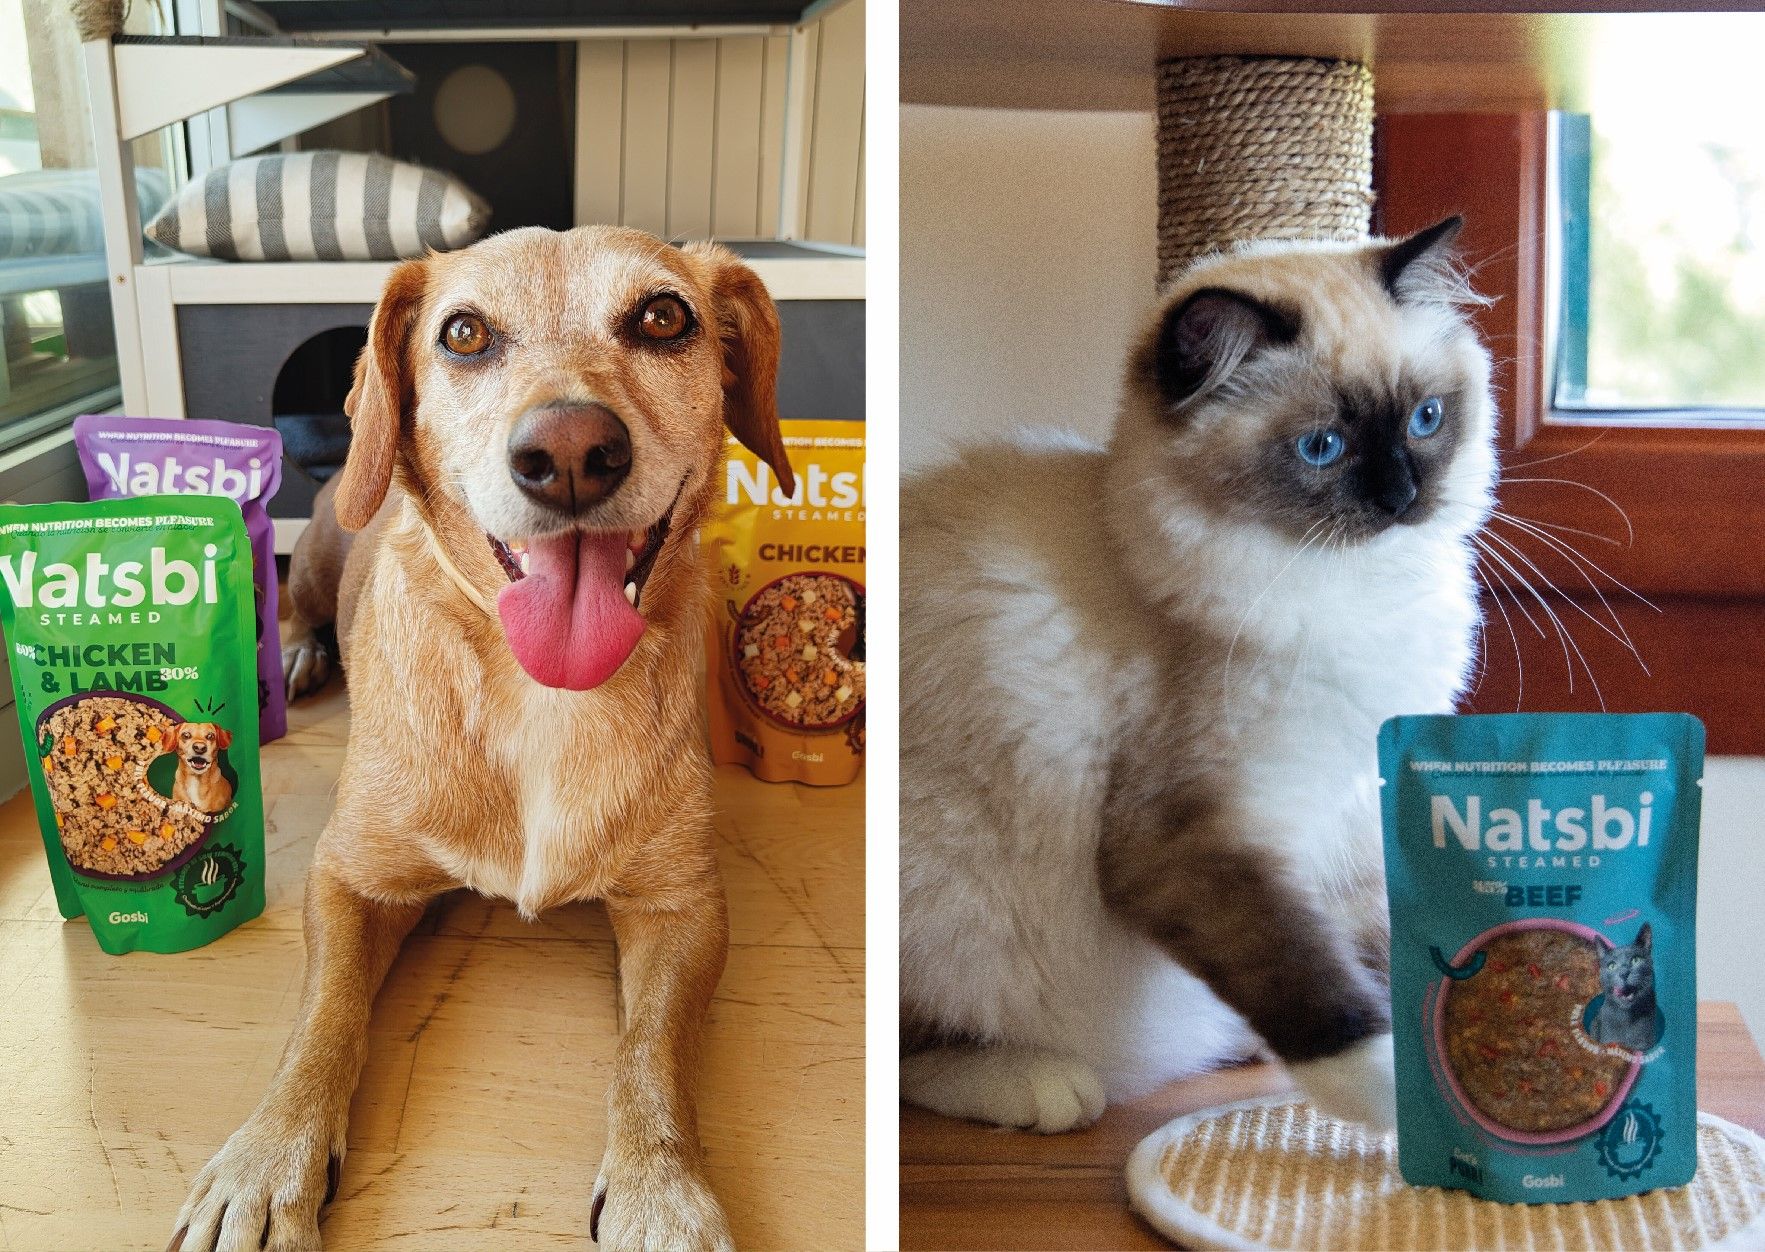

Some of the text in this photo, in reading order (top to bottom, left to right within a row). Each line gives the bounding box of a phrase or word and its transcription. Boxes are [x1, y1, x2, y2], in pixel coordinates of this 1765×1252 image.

[98, 431, 125, 440] WHEN
[127, 432, 172, 441] NUTRITION
[98, 452, 262, 499] Natsbi
[726, 459, 866, 508] Nats
[32, 519, 93, 531] NUTRITION
[95, 516, 153, 528] BECOMES
[155, 515, 214, 526] PLEASURE
[0, 543, 218, 608] Natsbi
[40, 611, 161, 626] STEAMED
[34, 642, 176, 668] CHICKEN
[41, 666, 199, 693] & LAMB 30%
[1409, 759, 1667, 772] WHEN NUTRITION BECOMES PLEASURE
[1431, 791, 1654, 851] Natsbi
[1487, 856, 1602, 869] STEAMED
[1505, 885, 1582, 908] BEEF
[109, 911, 148, 924] Gosbi
[1522, 1174, 1565, 1188] Gosbi
